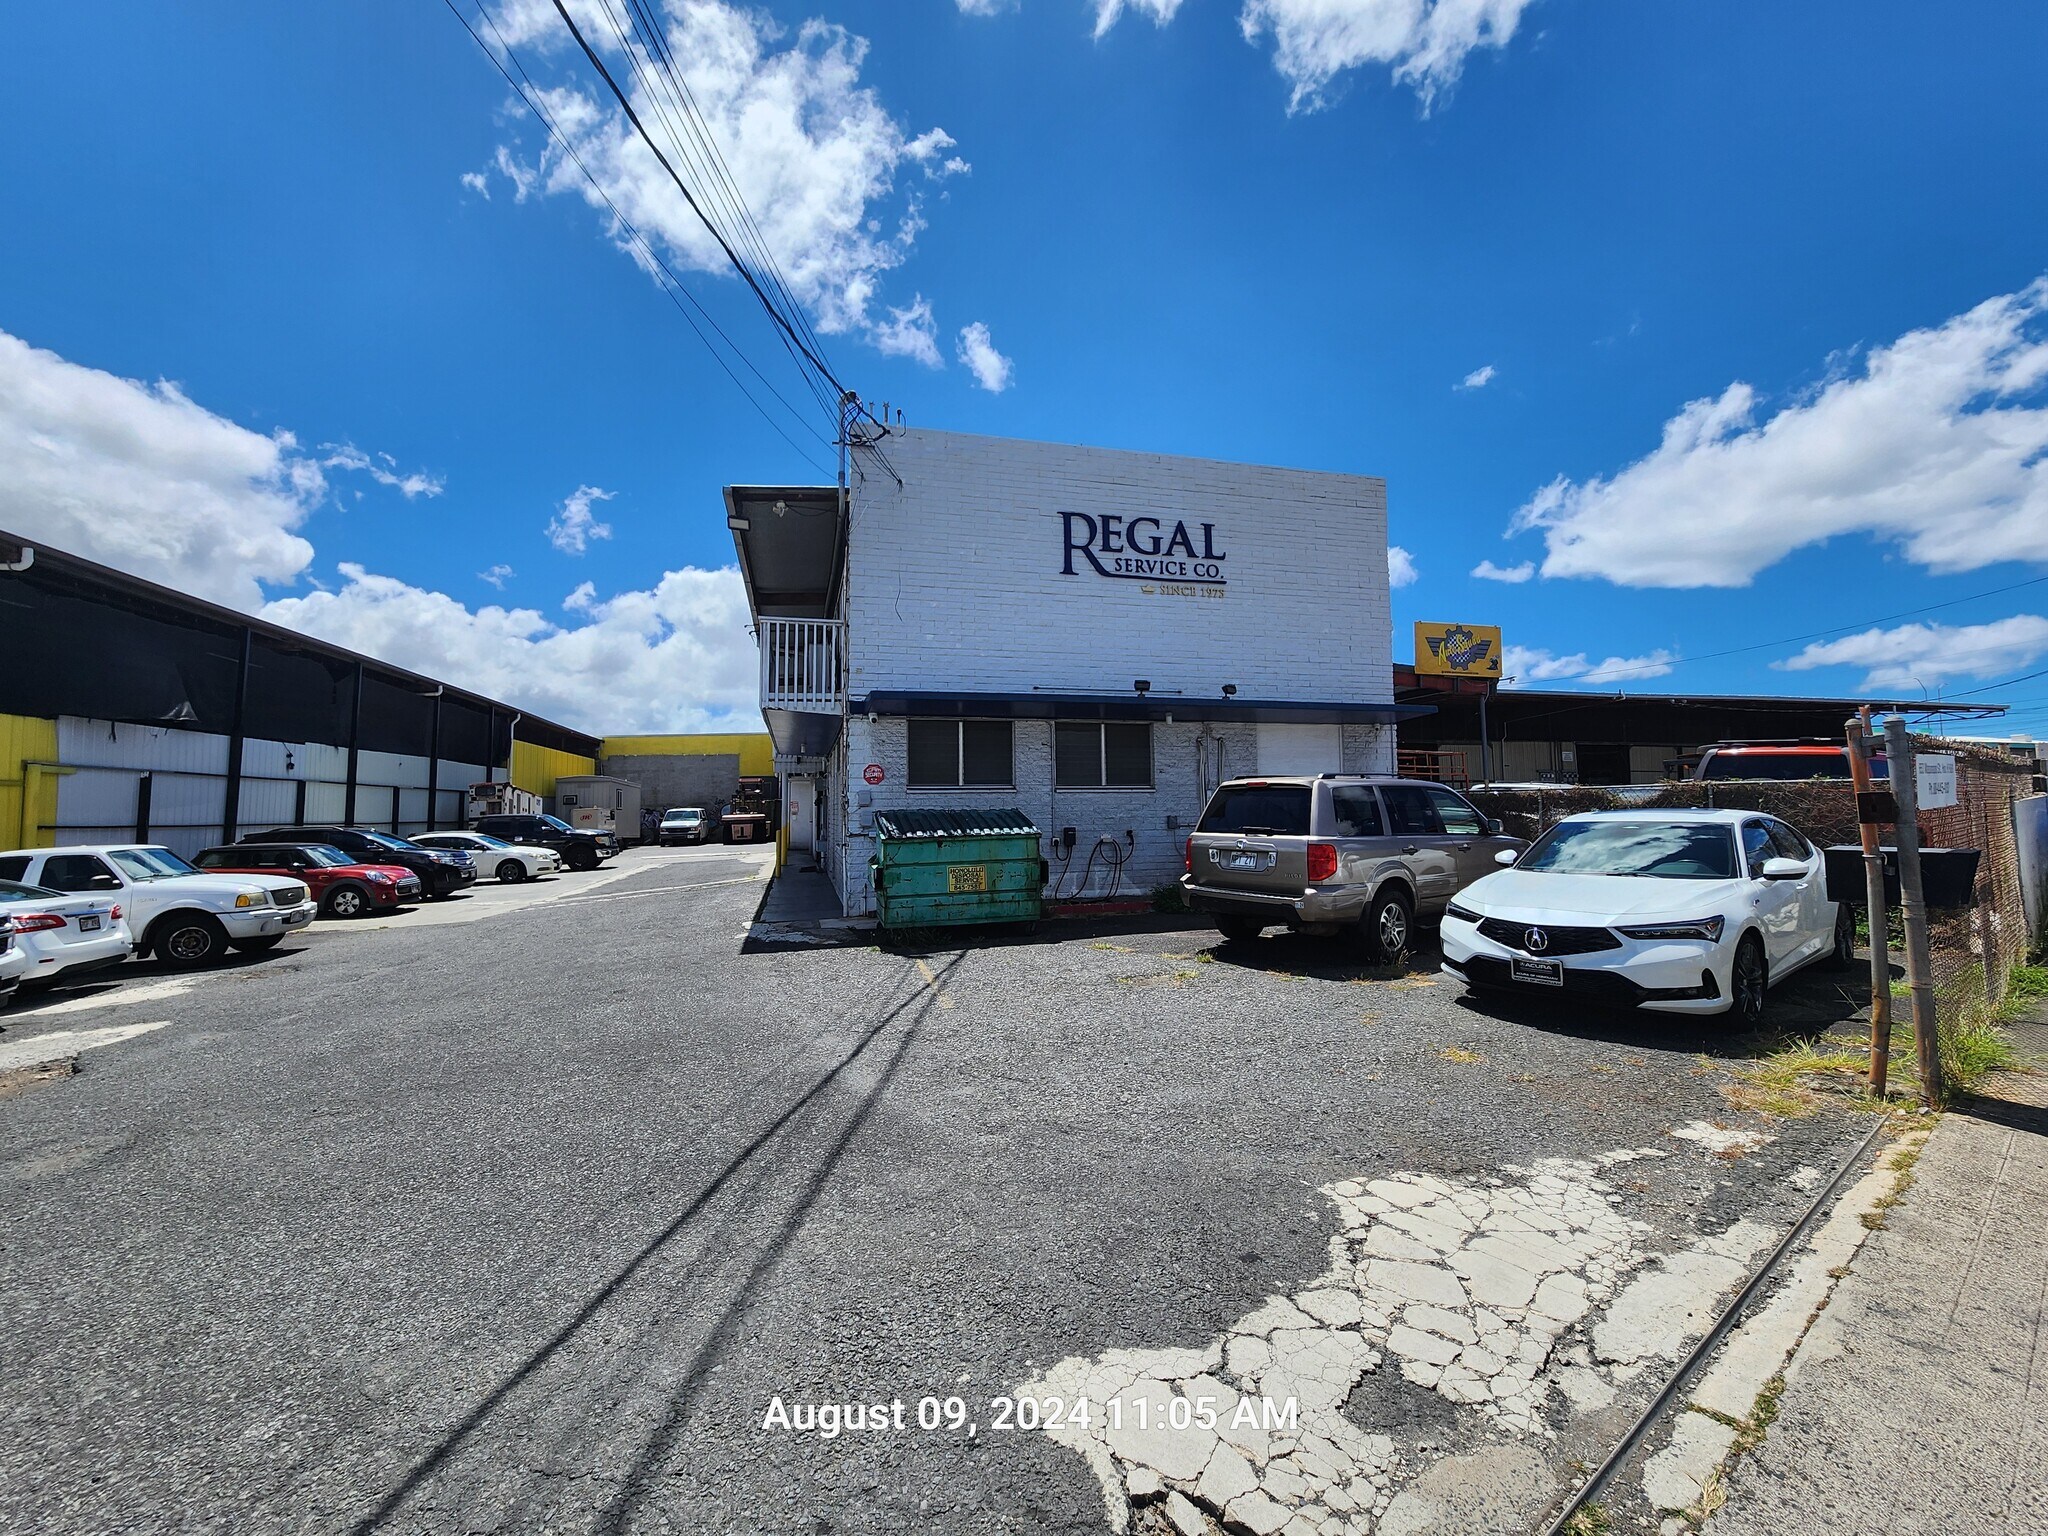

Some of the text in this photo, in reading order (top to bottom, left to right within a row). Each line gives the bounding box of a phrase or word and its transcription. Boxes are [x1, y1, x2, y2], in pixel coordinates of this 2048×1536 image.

[1057, 511, 1226, 575] REGAL
[1115, 558, 1224, 579] SERVICE CO.
[1160, 585, 1197, 597] SINCE
[1525, 962, 1553, 970] ACURA
